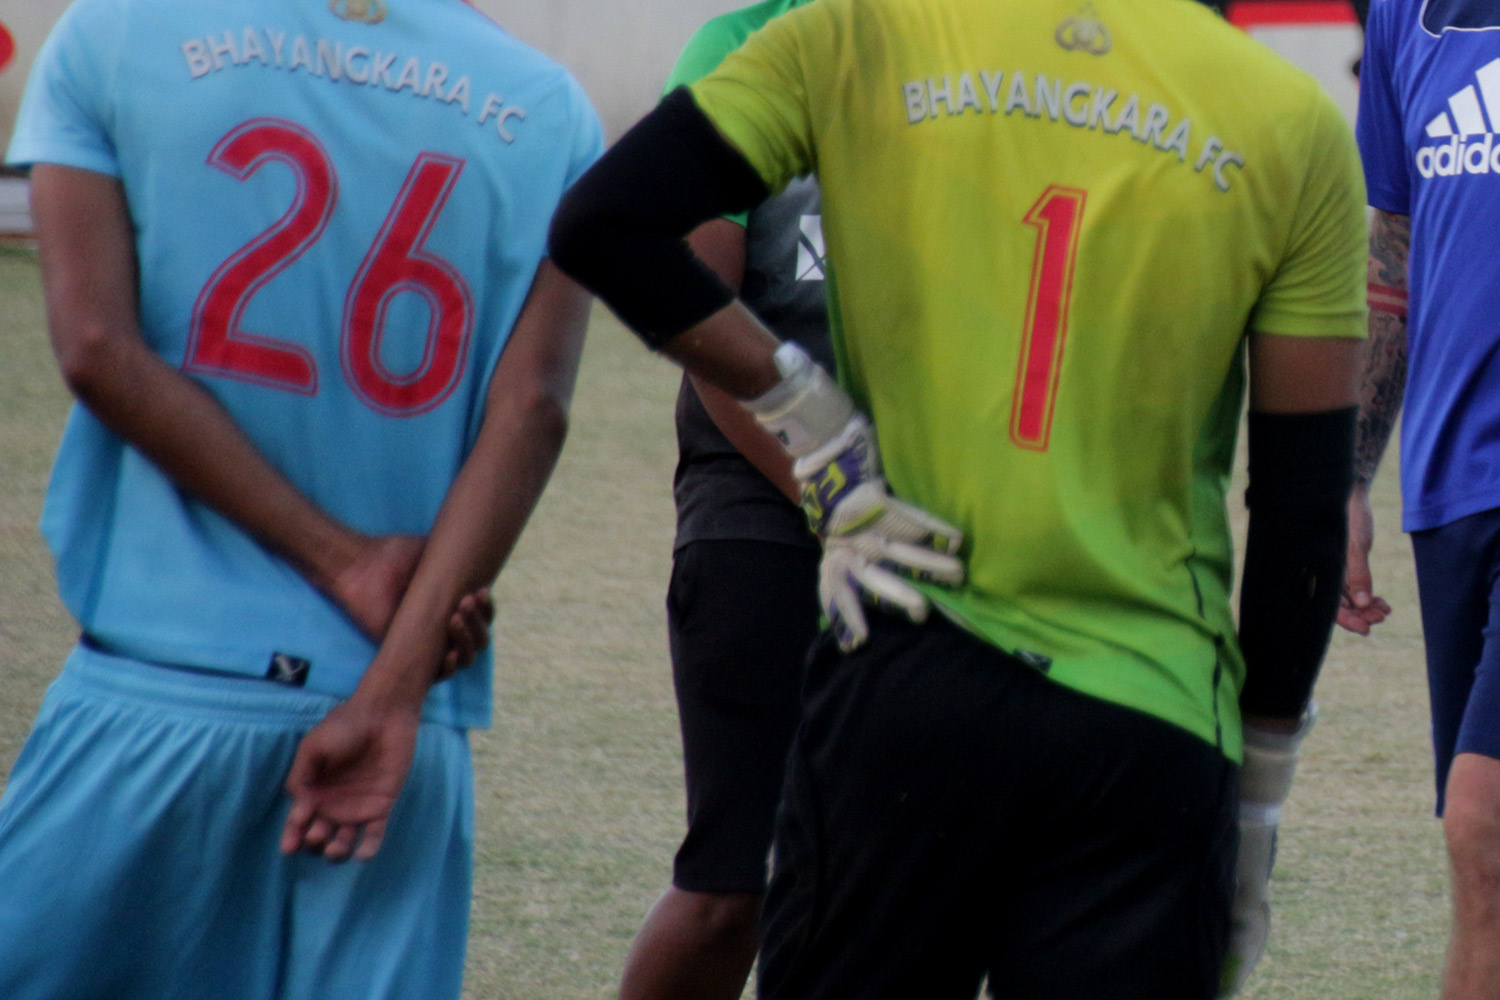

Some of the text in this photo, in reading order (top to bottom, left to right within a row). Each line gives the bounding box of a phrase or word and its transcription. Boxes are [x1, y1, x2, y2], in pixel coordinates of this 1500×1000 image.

[180, 25, 526, 144] BHAYANGKARA FC
[902, 69, 1245, 192] BHAYANGKARA FC
[183, 117, 475, 418] 26
[1008, 184, 1088, 453] 1
